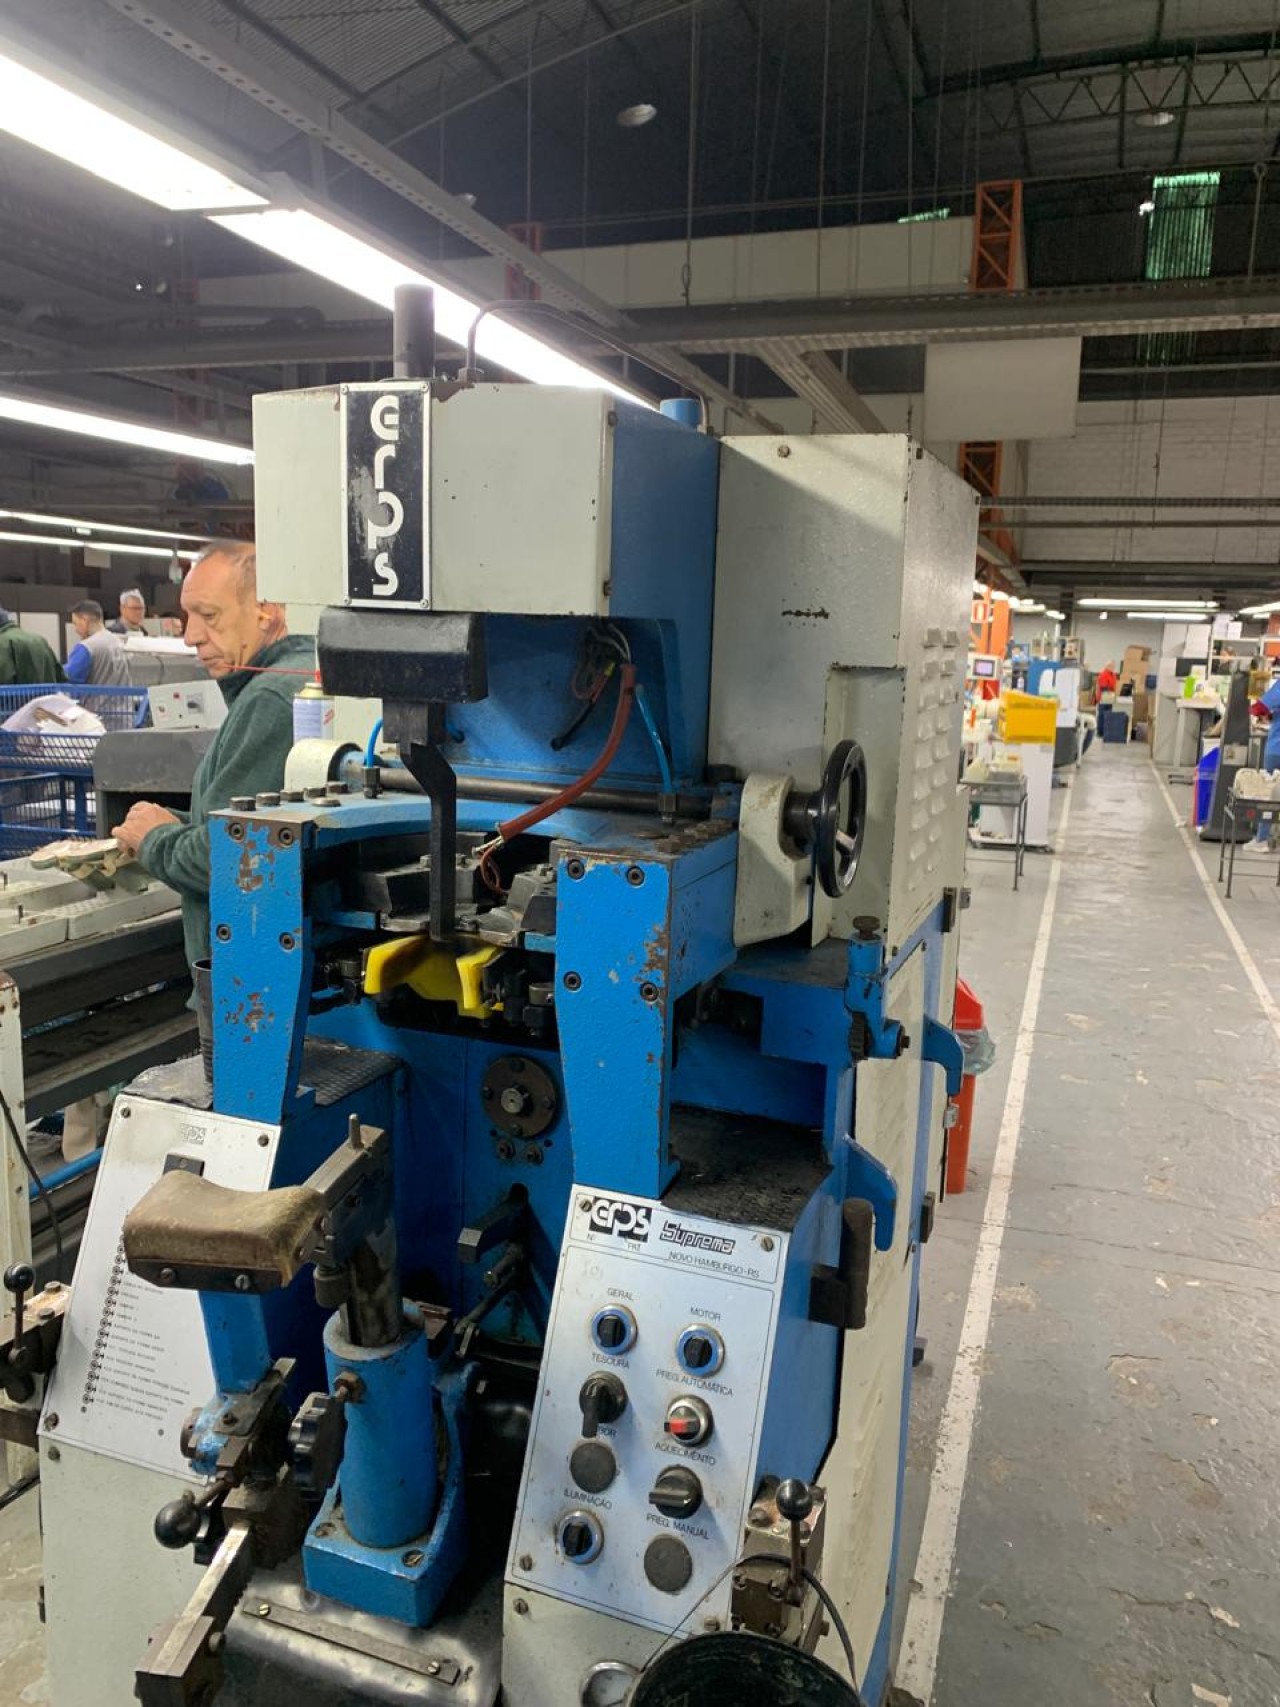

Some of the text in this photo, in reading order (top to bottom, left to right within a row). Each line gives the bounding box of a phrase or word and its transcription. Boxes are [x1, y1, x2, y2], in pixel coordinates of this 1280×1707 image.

[668, 1251, 693, 1264] NOVO
[607, 1287, 634, 1301] GERAL
[690, 1306, 721, 1321] MOTOR
[591, 1352, 630, 1369] TESOURA
[655, 1440, 717, 1466] AQUECIMENTO
[672, 1519, 710, 1540] MANUAL
